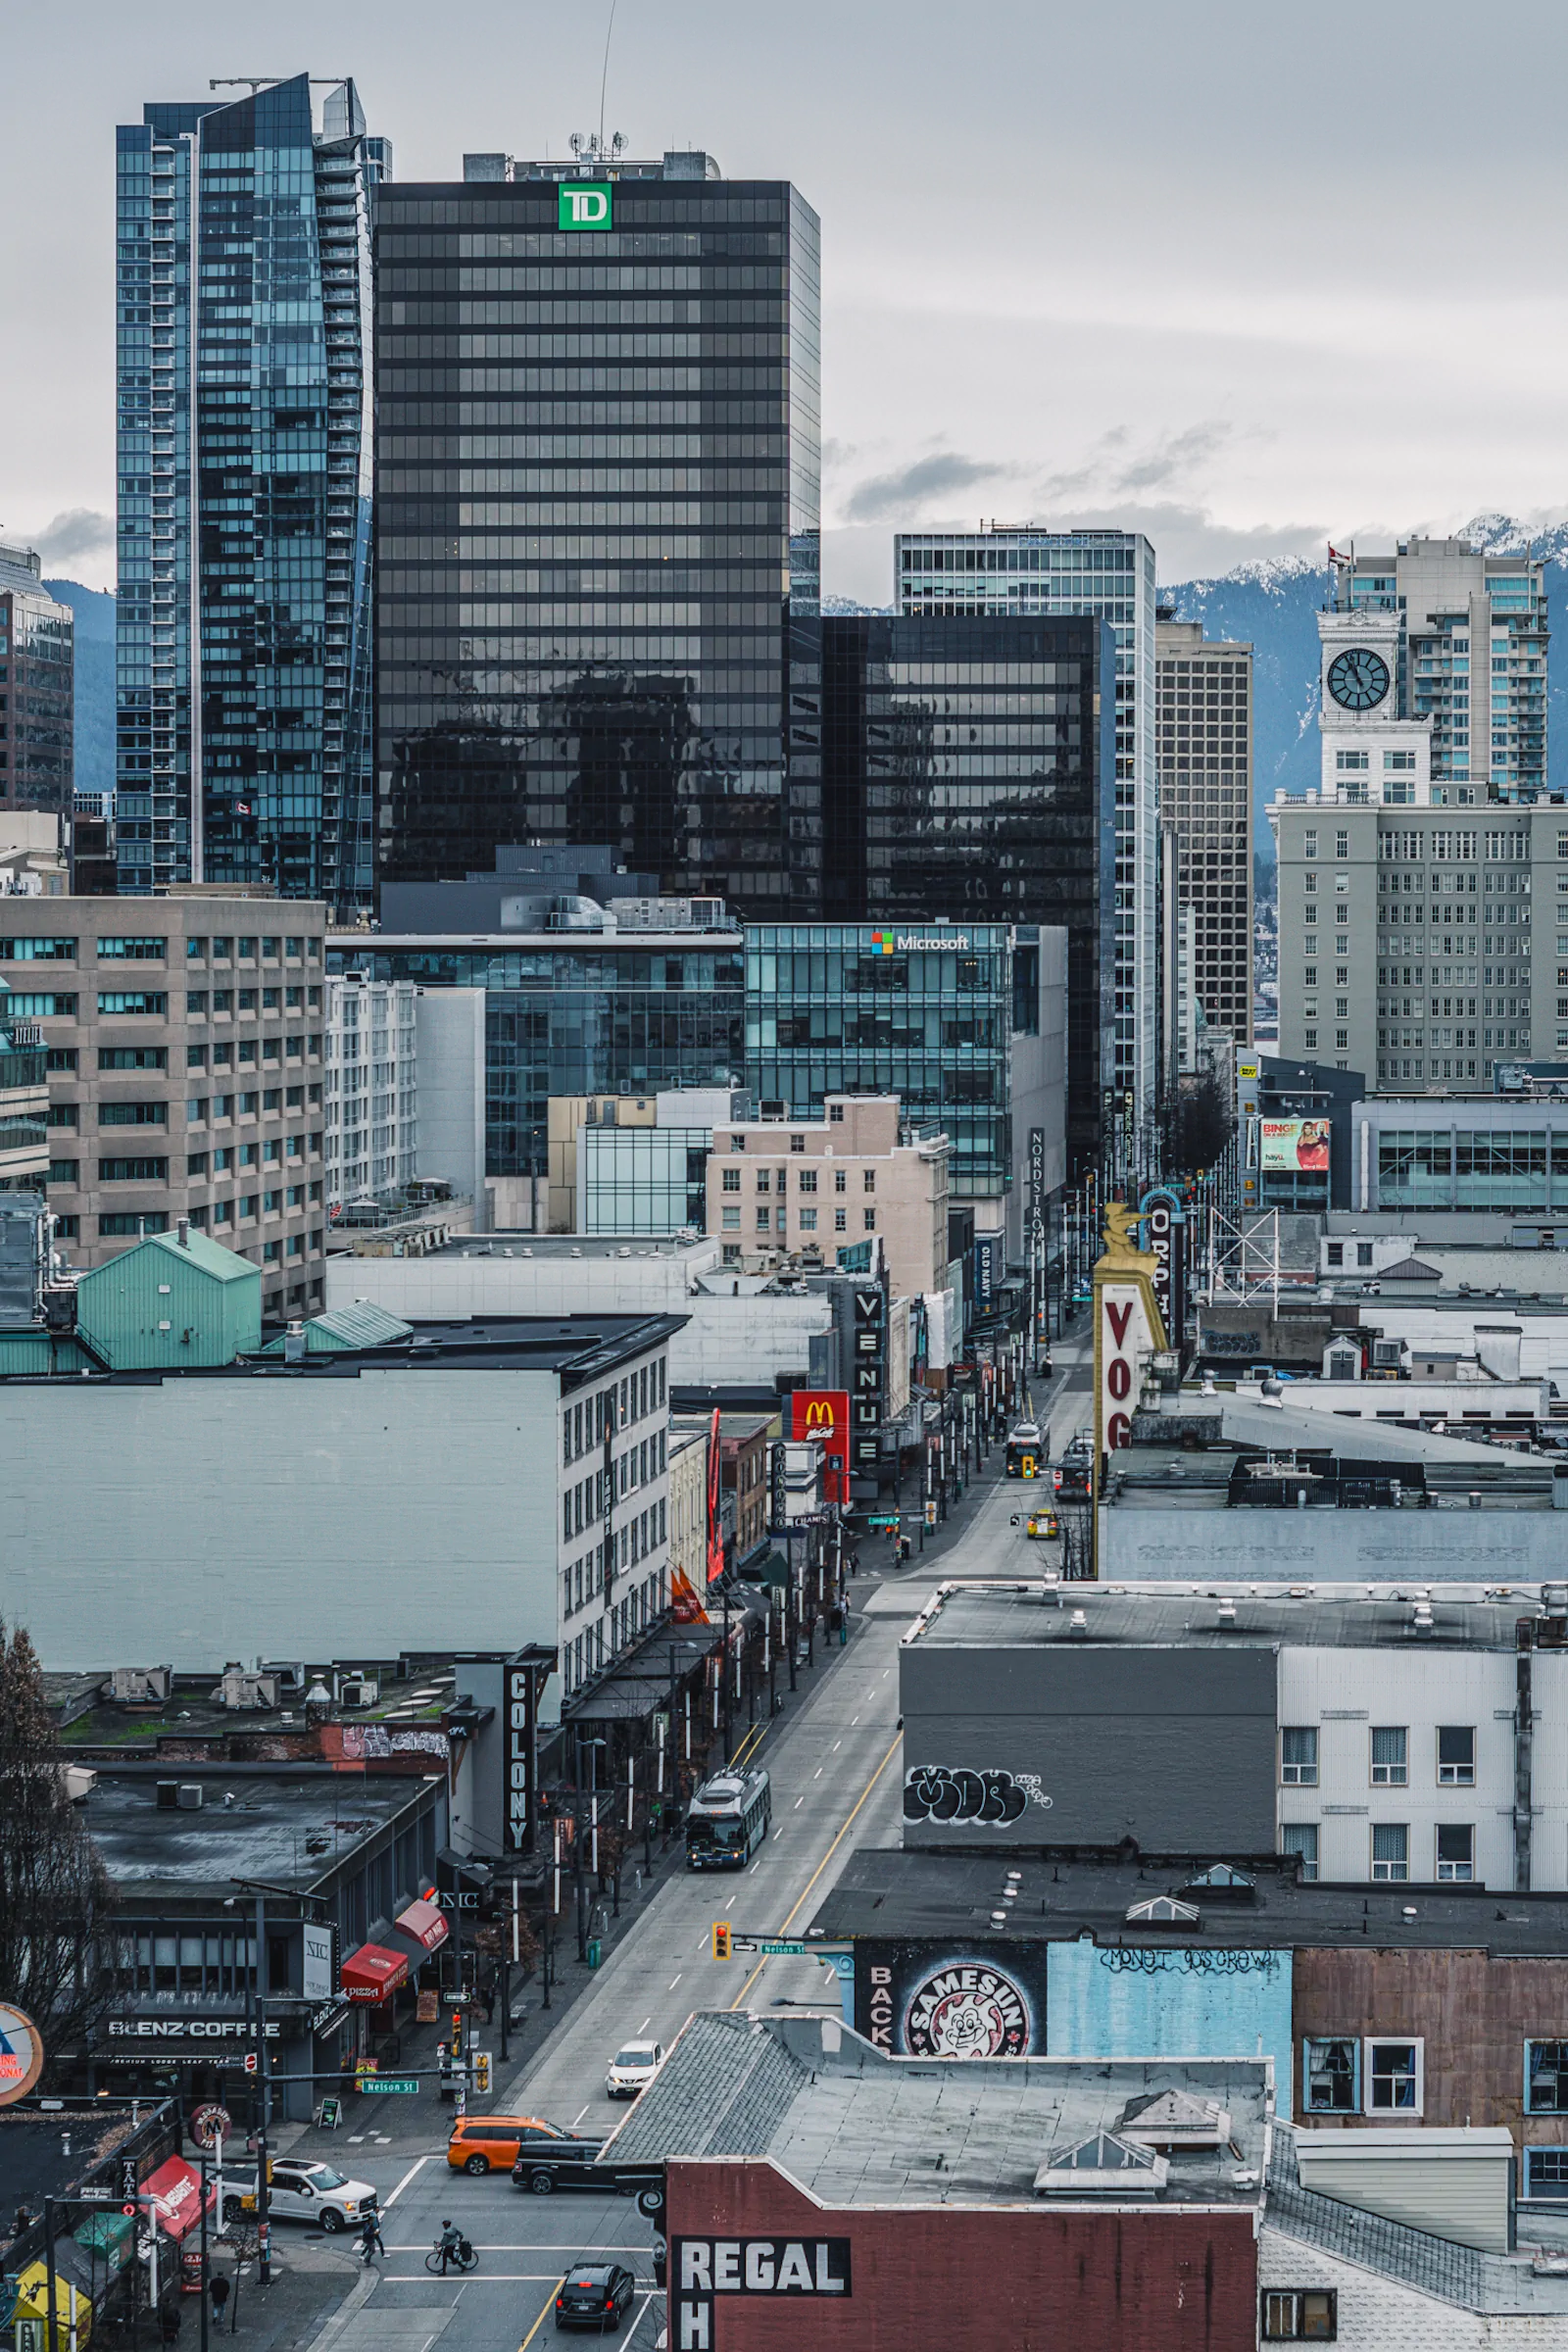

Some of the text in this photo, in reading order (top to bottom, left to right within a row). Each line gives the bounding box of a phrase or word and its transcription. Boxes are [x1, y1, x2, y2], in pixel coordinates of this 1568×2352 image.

[564, 191, 607, 221] TD
[897, 935, 968, 950] Microsoft
[981, 1246, 991, 1298] OLD NAVY
[857, 1295, 878, 1458] VENUE
[510, 1673, 526, 1848] COLONY
[765, 1944, 793, 1953] Nelson
[349, 1987, 378, 1997] PIZZA
[911, 1970, 1023, 2031] SAMESUN
[109, 2022, 280, 2036] BLENZ COFFEE
[681, 2242, 844, 2290] REGAL
